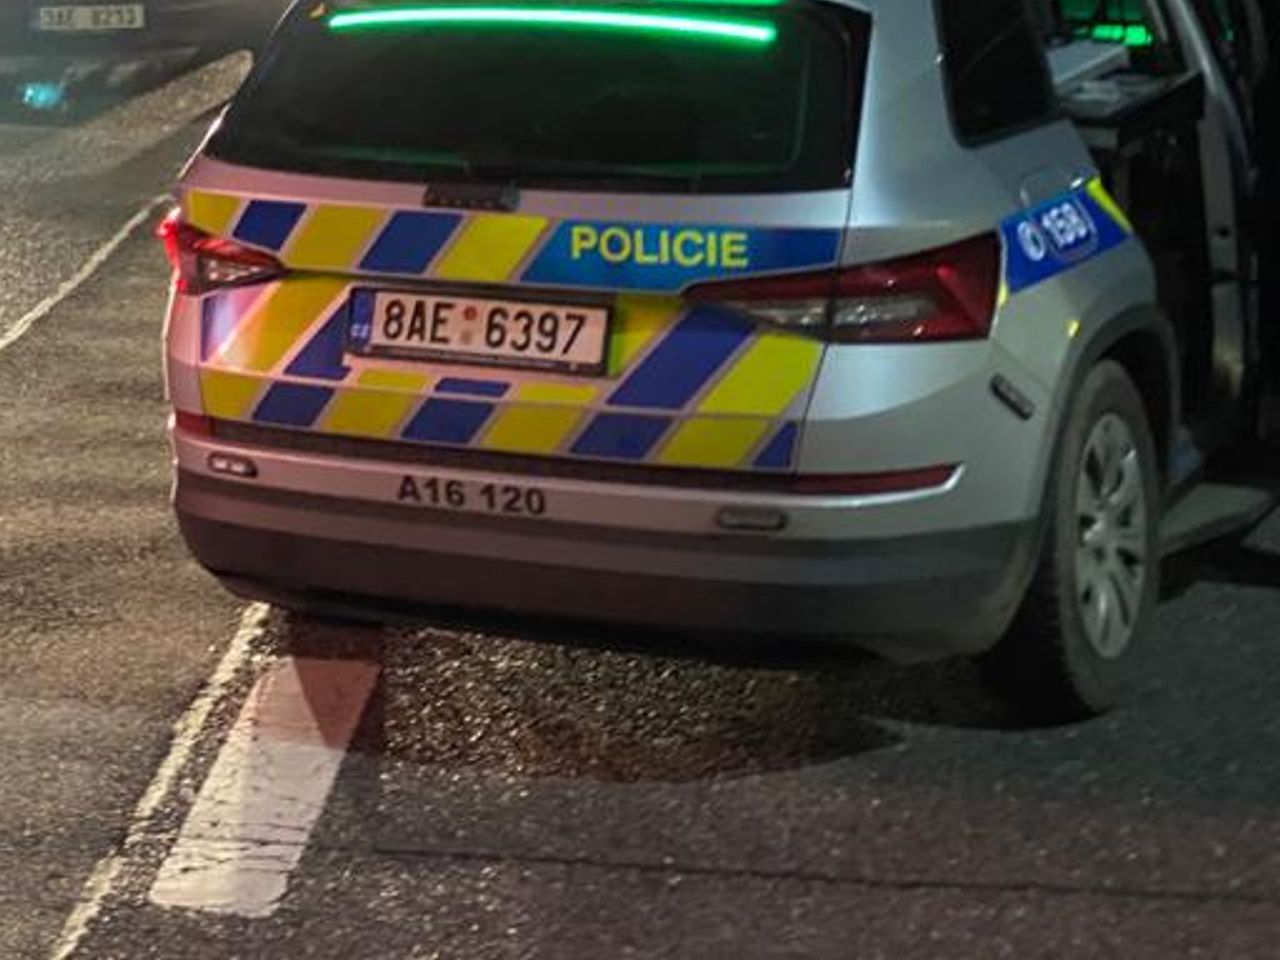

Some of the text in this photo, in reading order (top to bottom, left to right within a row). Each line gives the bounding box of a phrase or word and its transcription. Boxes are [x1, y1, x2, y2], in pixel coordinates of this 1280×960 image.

[571, 224, 749, 268] POLICIE
[382, 298, 587, 356] 8AE 6397
[397, 474, 546, 515] A16 120
